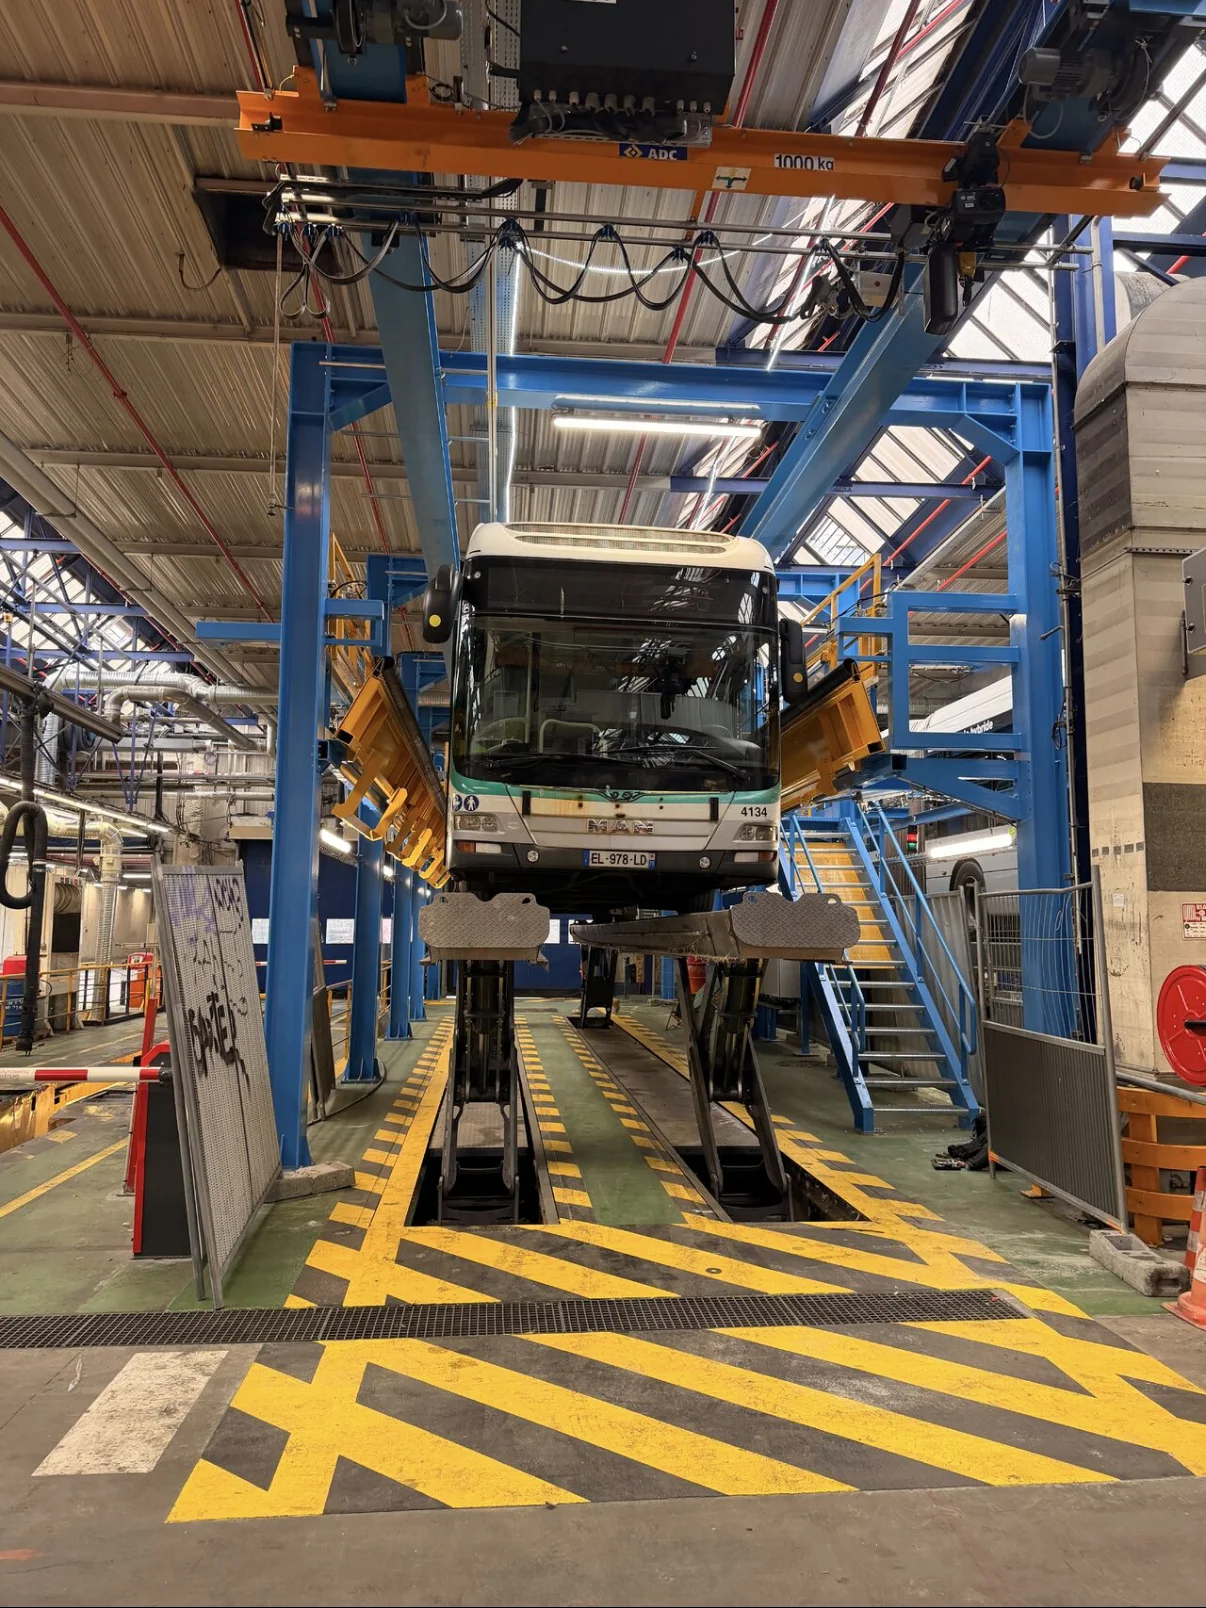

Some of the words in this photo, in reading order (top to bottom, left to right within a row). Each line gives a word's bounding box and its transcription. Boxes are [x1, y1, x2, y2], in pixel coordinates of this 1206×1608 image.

[648, 148, 678, 161] ADC
[776, 154, 814, 170] 1000
[741, 806, 768, 818] 4134
[587, 818, 654, 835] MAN
[591, 852, 647, 866] EL-978-LD
